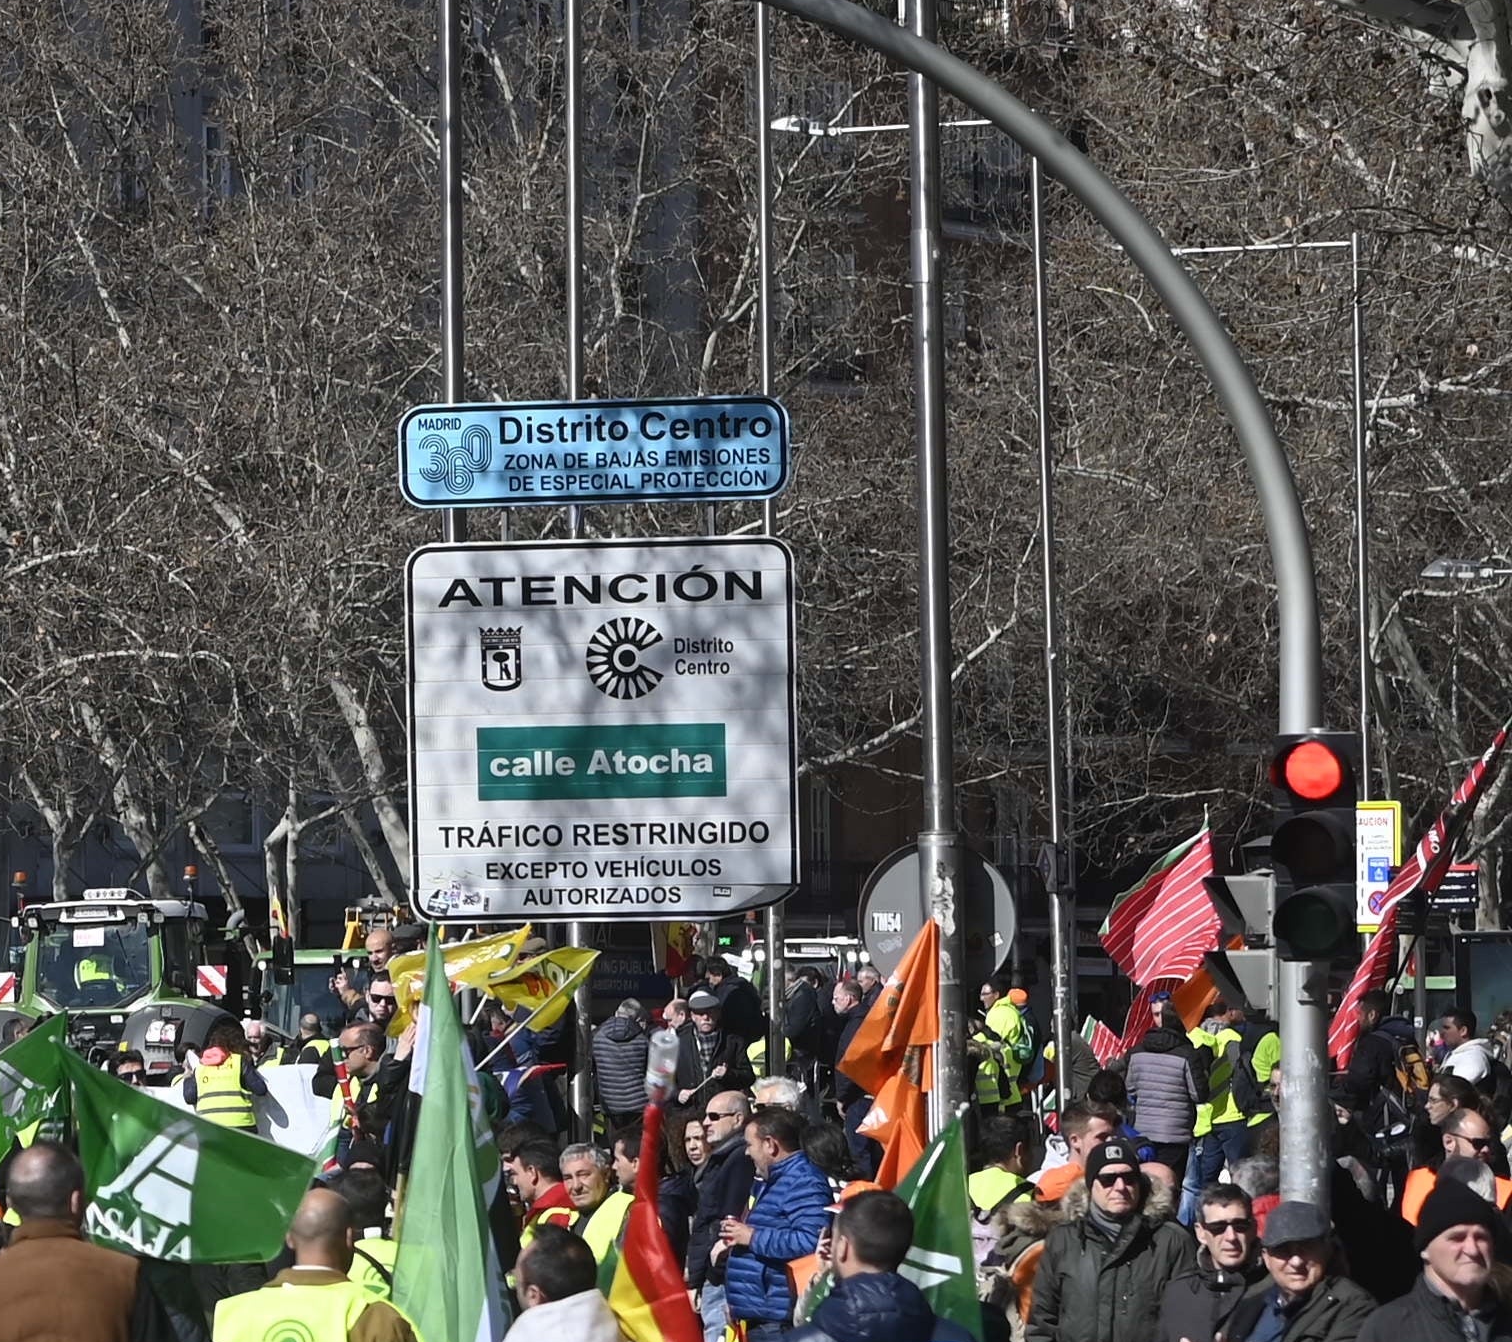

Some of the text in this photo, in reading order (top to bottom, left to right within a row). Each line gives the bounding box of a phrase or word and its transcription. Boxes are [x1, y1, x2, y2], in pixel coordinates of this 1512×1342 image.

[418, 417, 462, 431] MADRID
[499, 411, 772, 445] Distrito Centro
[504, 448, 770, 470] ZONA DE BAJAS EMISIONES
[509, 467, 767, 492] DE ESPECIAL PROTECCIÓN
[438, 564, 763, 608] ATENCIÓN
[674, 638, 734, 654] Distrito
[675, 658, 730, 675] Centro
[489, 748, 713, 777] calle Atocha
[439, 820, 769, 849] TRÁFICO RESTRINGIDO
[486, 856, 722, 880] EXCEPTO VEHÍCULOS
[523, 886, 682, 907] AUTORIZADOS
[620, 961, 652, 974] PUBLIC
